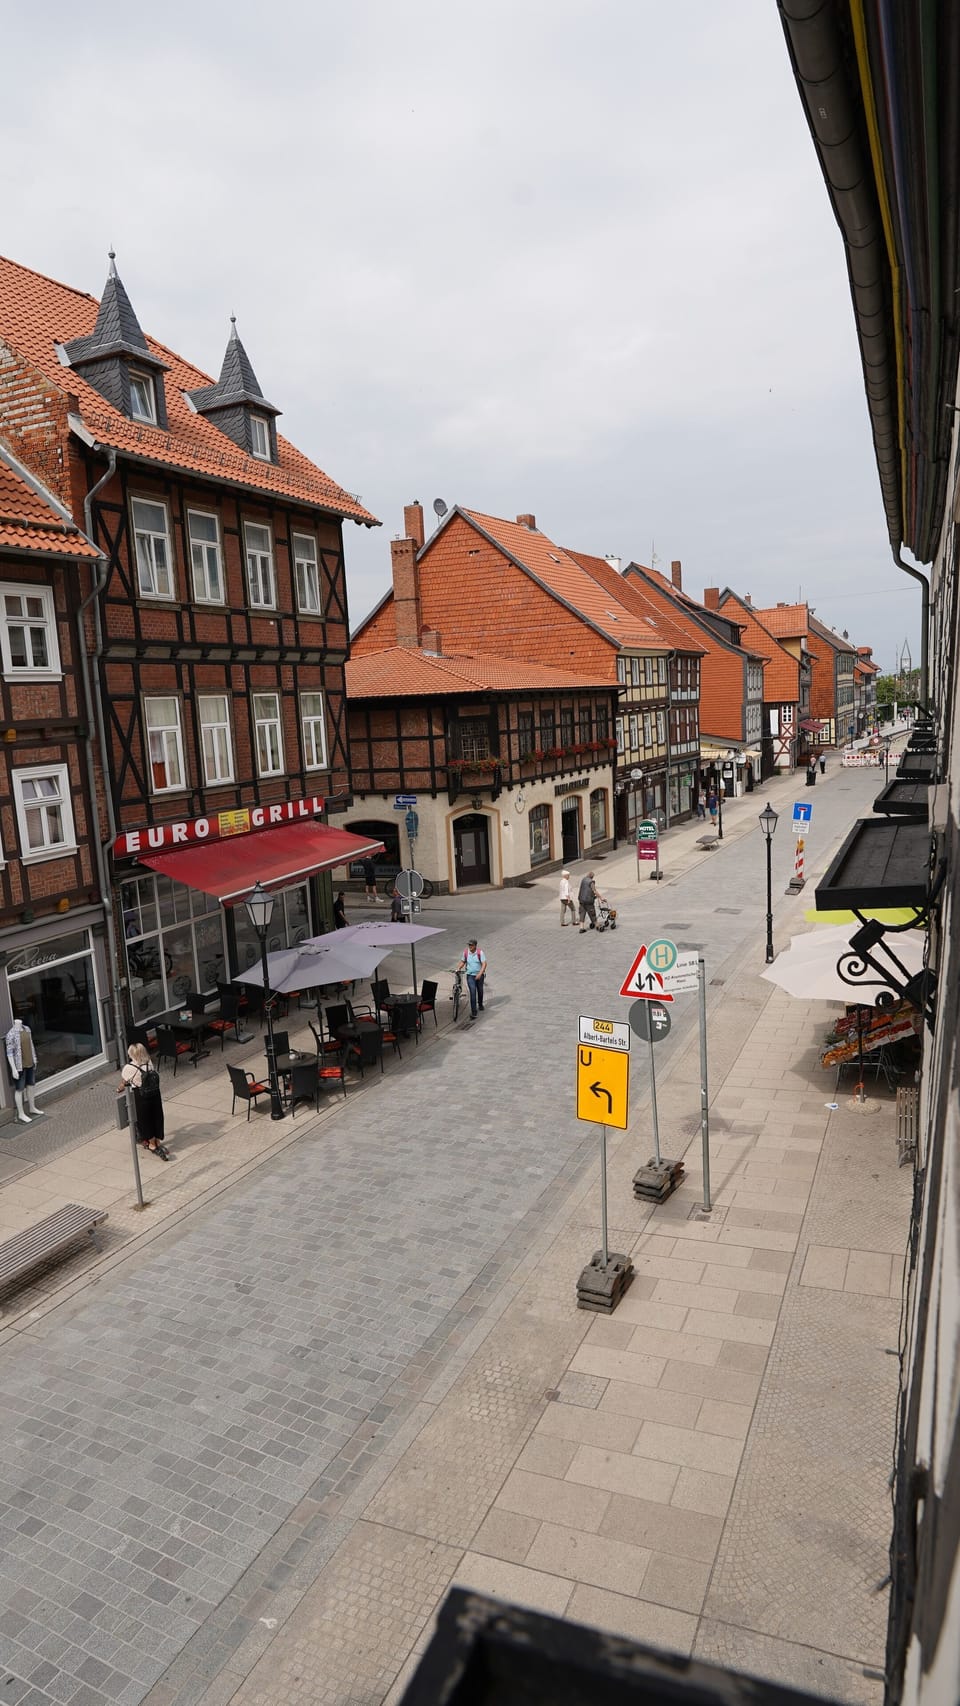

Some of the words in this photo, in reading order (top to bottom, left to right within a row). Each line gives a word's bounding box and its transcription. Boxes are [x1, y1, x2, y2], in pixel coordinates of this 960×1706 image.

[125, 818, 210, 853] EURO
[251, 797, 322, 826] GRILL
[655, 946, 668, 966] H
[595, 1021, 610, 1031] 244
[583, 1031, 618, 1045] Albert-Bartels
[580, 1050, 592, 1067] U
